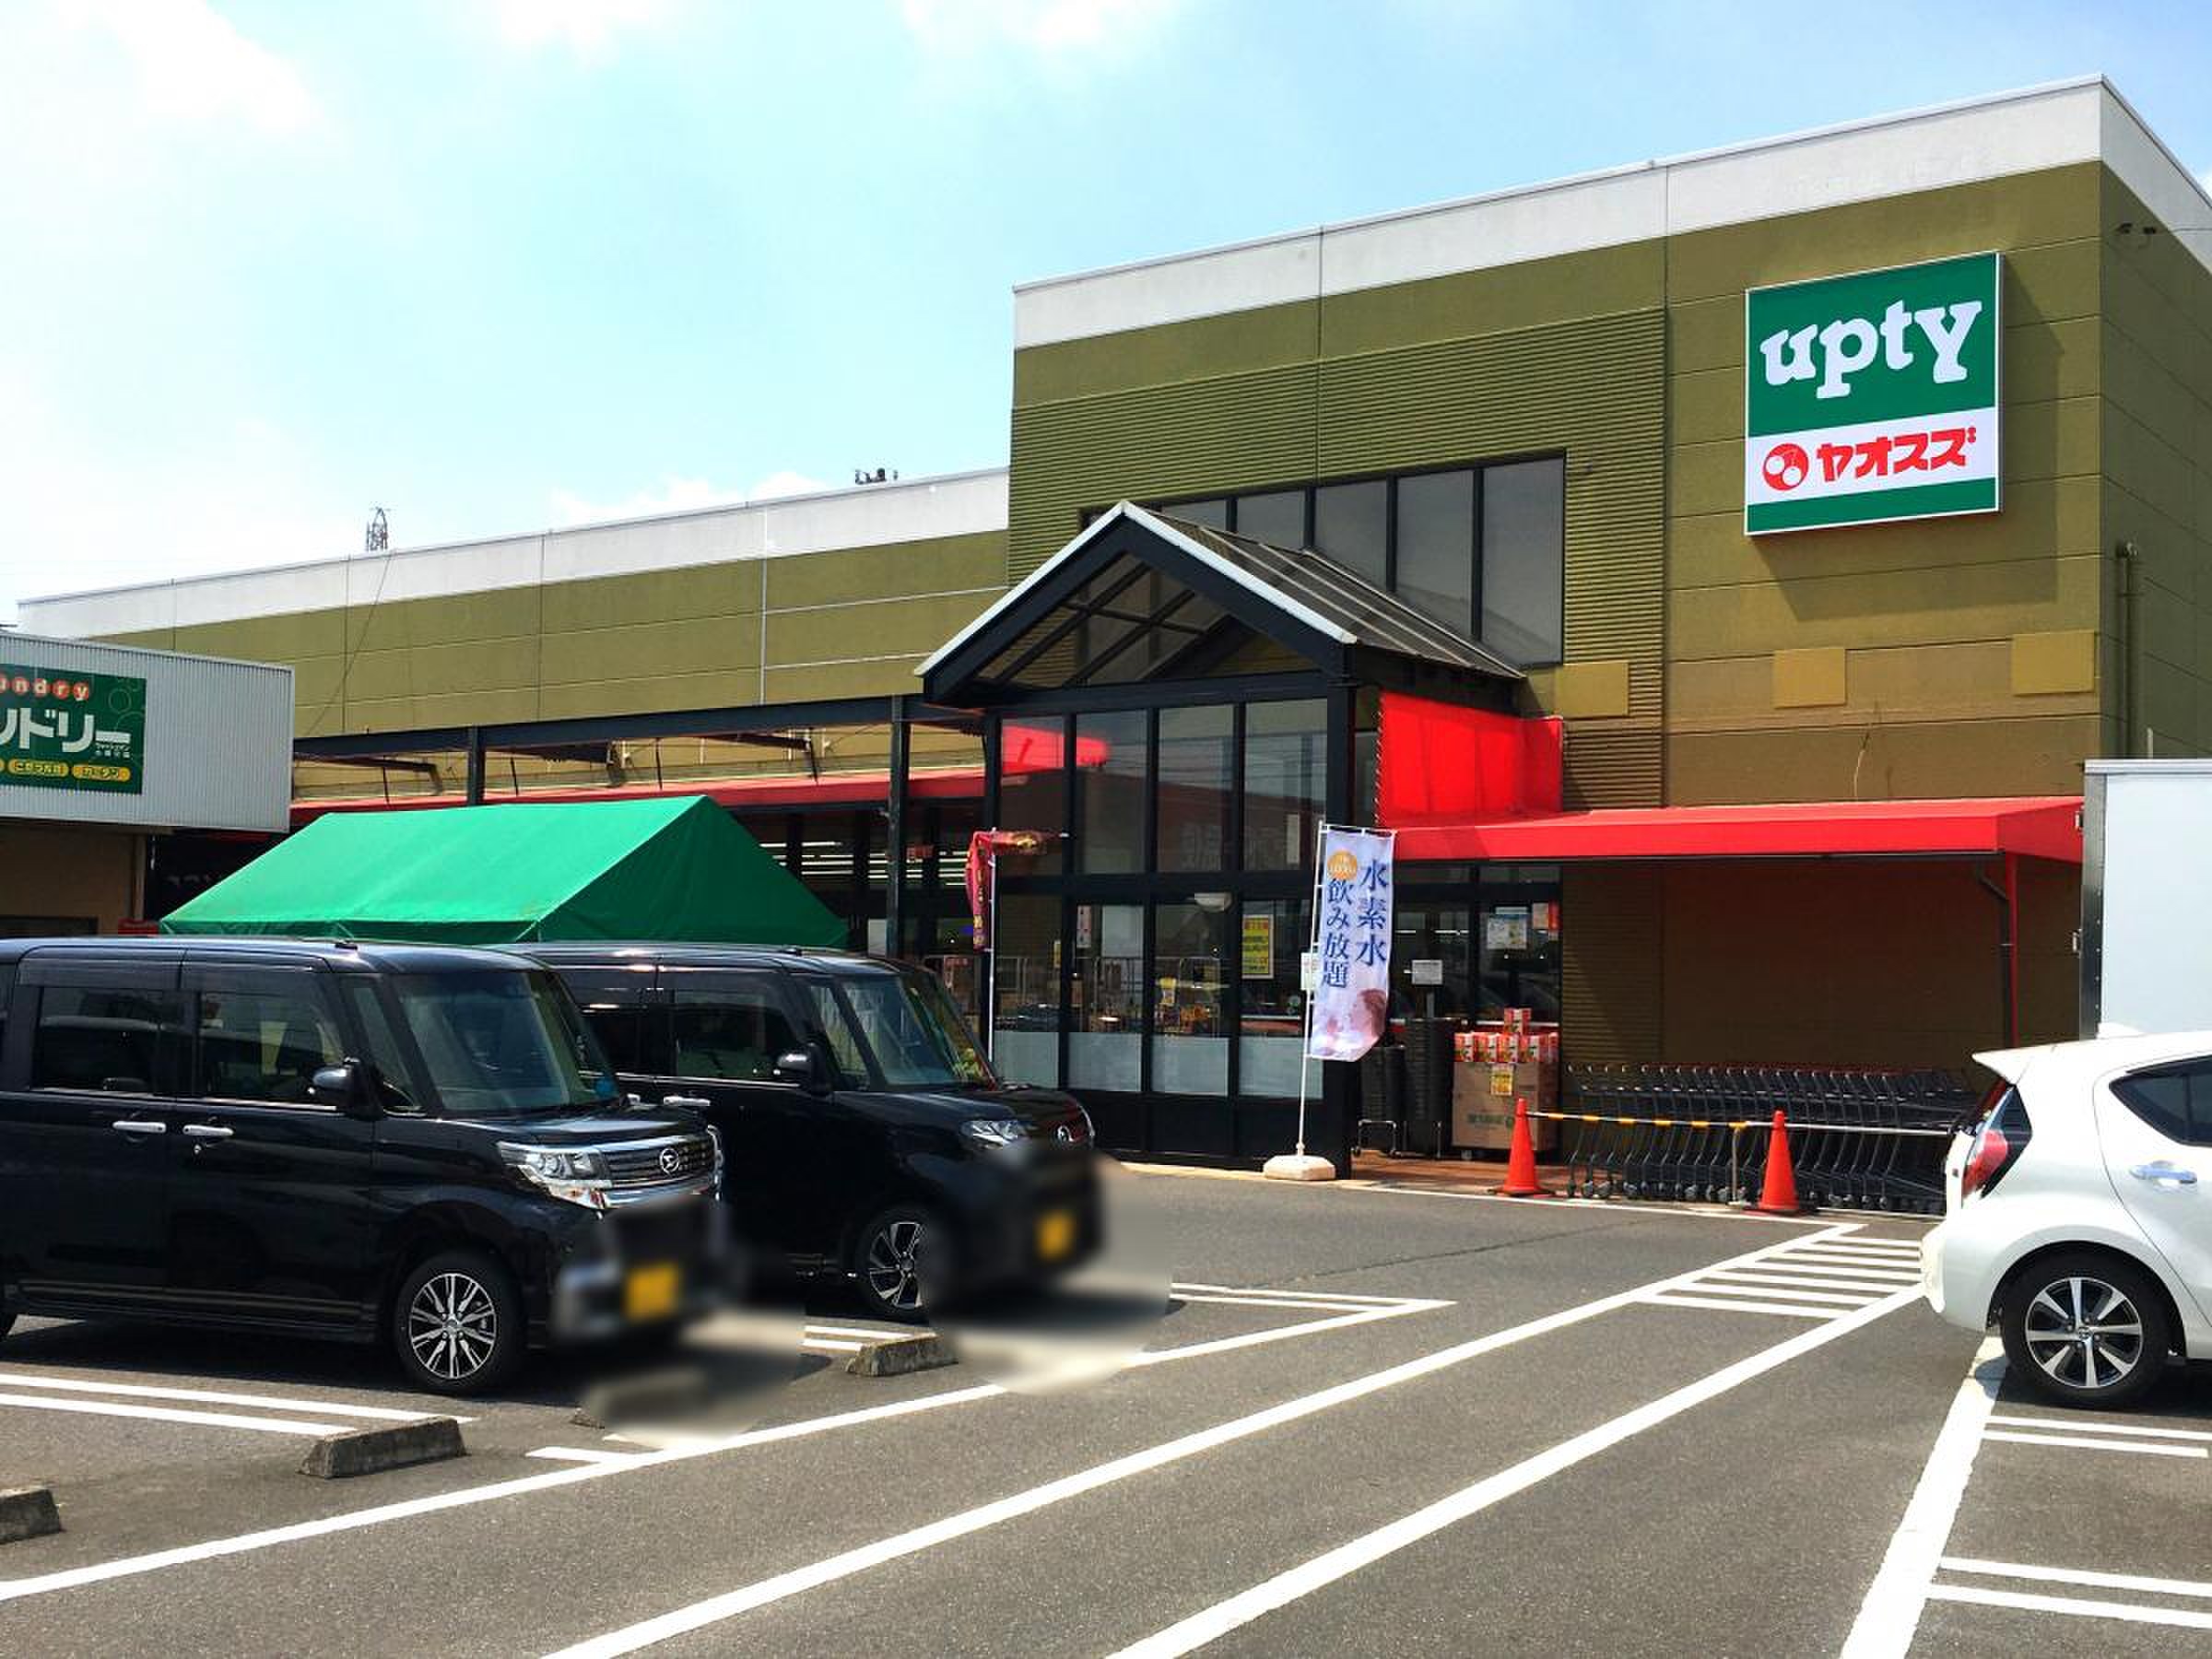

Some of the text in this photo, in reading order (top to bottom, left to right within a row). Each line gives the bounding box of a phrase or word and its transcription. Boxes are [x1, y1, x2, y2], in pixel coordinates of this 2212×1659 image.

[1759, 300, 1982, 399] upty
[1817, 427, 1976, 482] ヤオスズ
[1322, 877, 1353, 989] 飲み放題
[1355, 859, 1388, 967] 水素水
